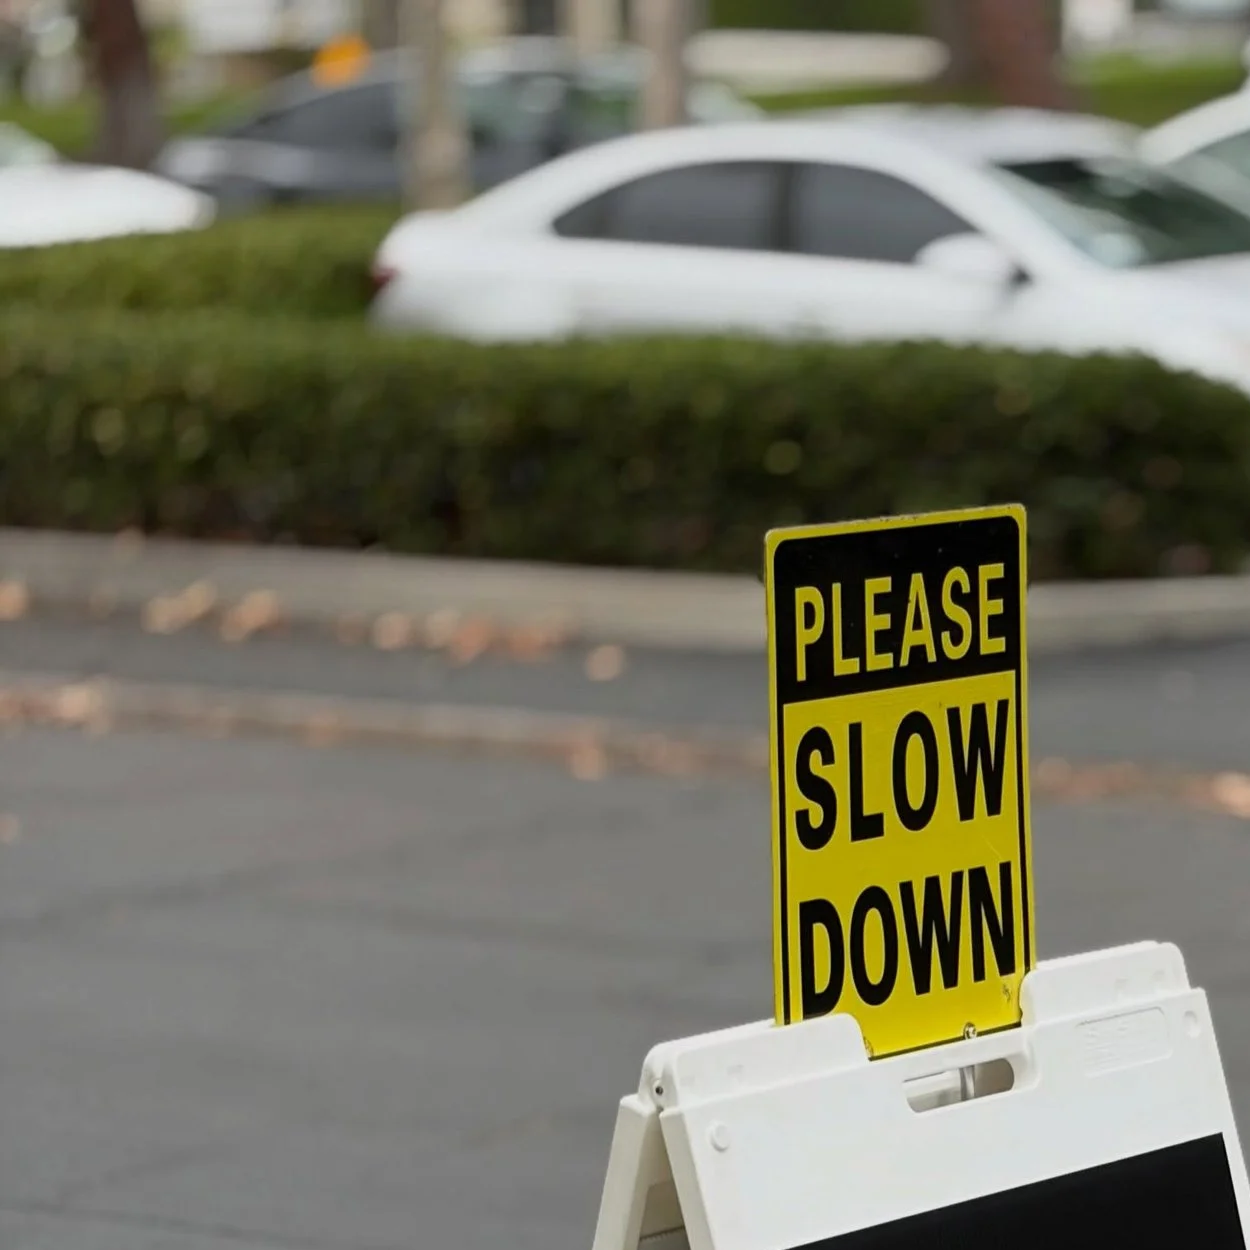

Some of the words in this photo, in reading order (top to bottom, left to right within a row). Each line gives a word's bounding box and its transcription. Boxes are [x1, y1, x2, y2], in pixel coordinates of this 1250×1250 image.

[795, 563, 1006, 681] PLEASE
[795, 699, 1009, 850] SLOW
[800, 861, 1015, 1020] DOWN
